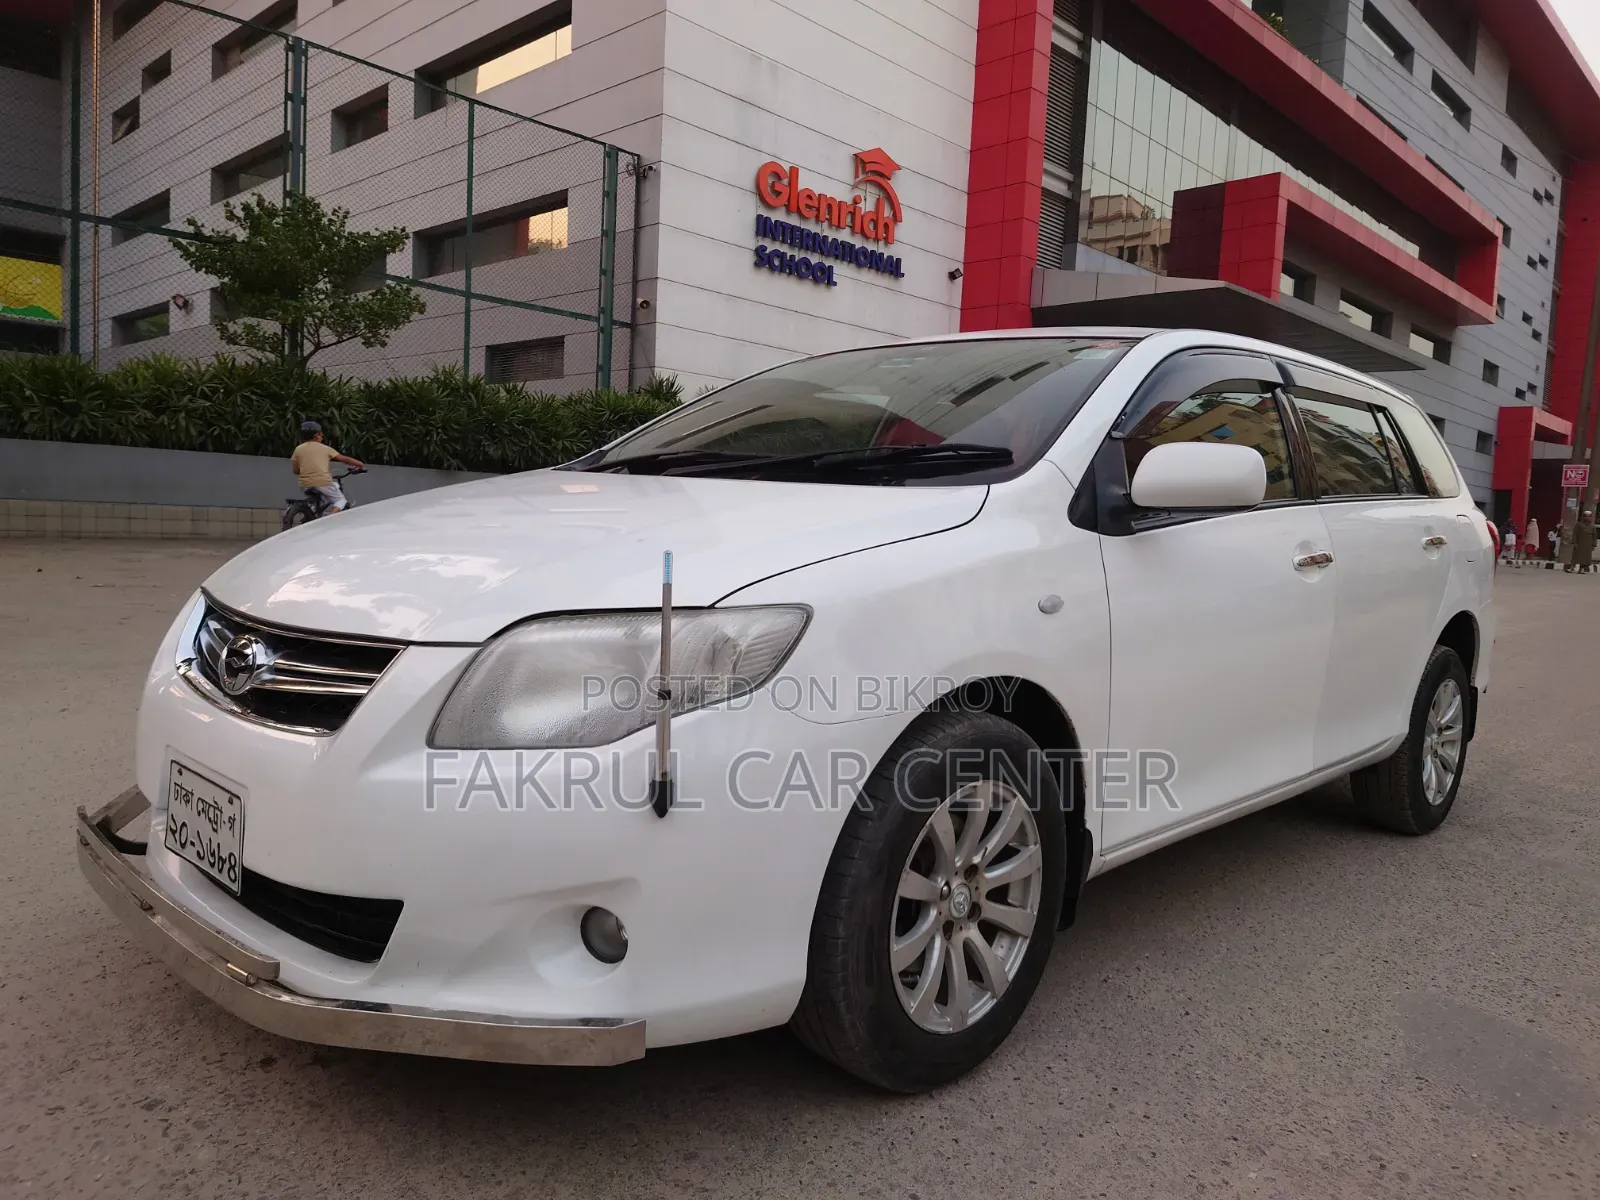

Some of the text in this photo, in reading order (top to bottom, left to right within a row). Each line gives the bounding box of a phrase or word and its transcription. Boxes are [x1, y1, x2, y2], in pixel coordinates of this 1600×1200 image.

[756, 161, 896, 244] Glenrich
[754, 245, 837, 286] SCHOOL
[756, 214, 905, 278] INTERNATIONAL
[173, 781, 194, 811] ঢাকা
[169, 813, 238, 884] ২০-১৬৮৪
